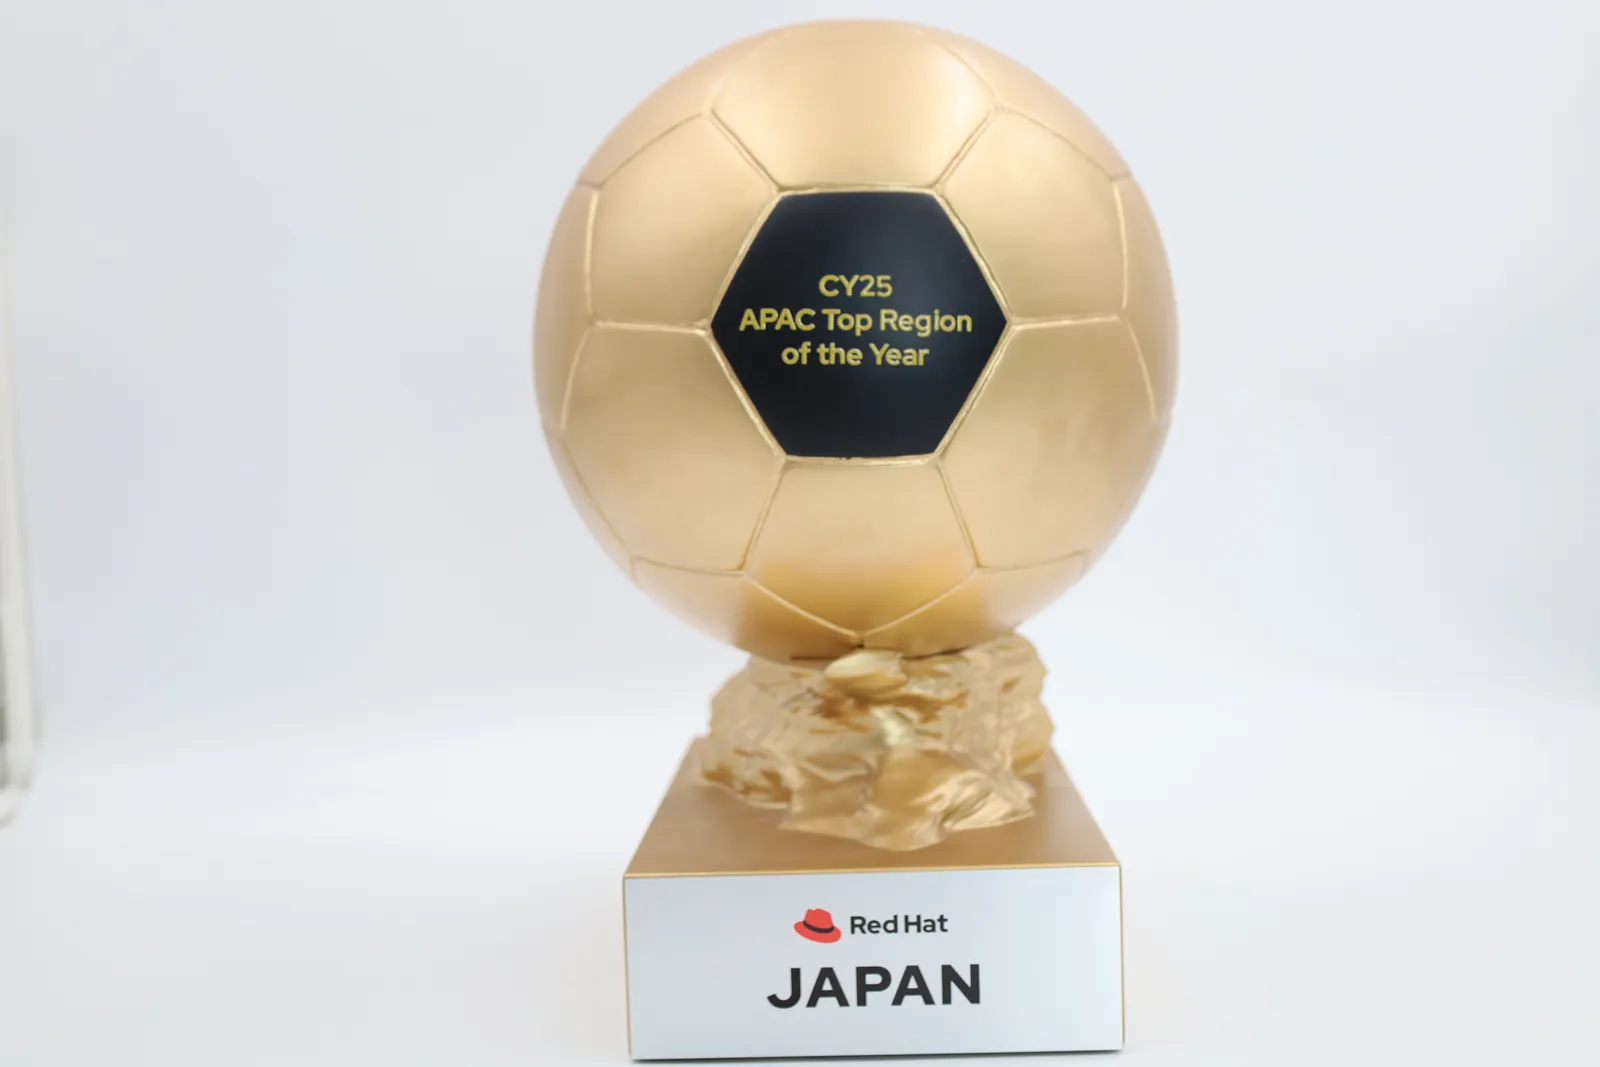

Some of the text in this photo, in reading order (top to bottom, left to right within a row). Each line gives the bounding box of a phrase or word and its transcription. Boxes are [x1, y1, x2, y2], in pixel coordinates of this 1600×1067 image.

[818, 273, 893, 298] CY25
[738, 308, 973, 338] APAC Top Region
[781, 341, 930, 366] of the Year
[850, 914, 949, 935] Red Hat
[766, 963, 981, 1010] JAPAN
